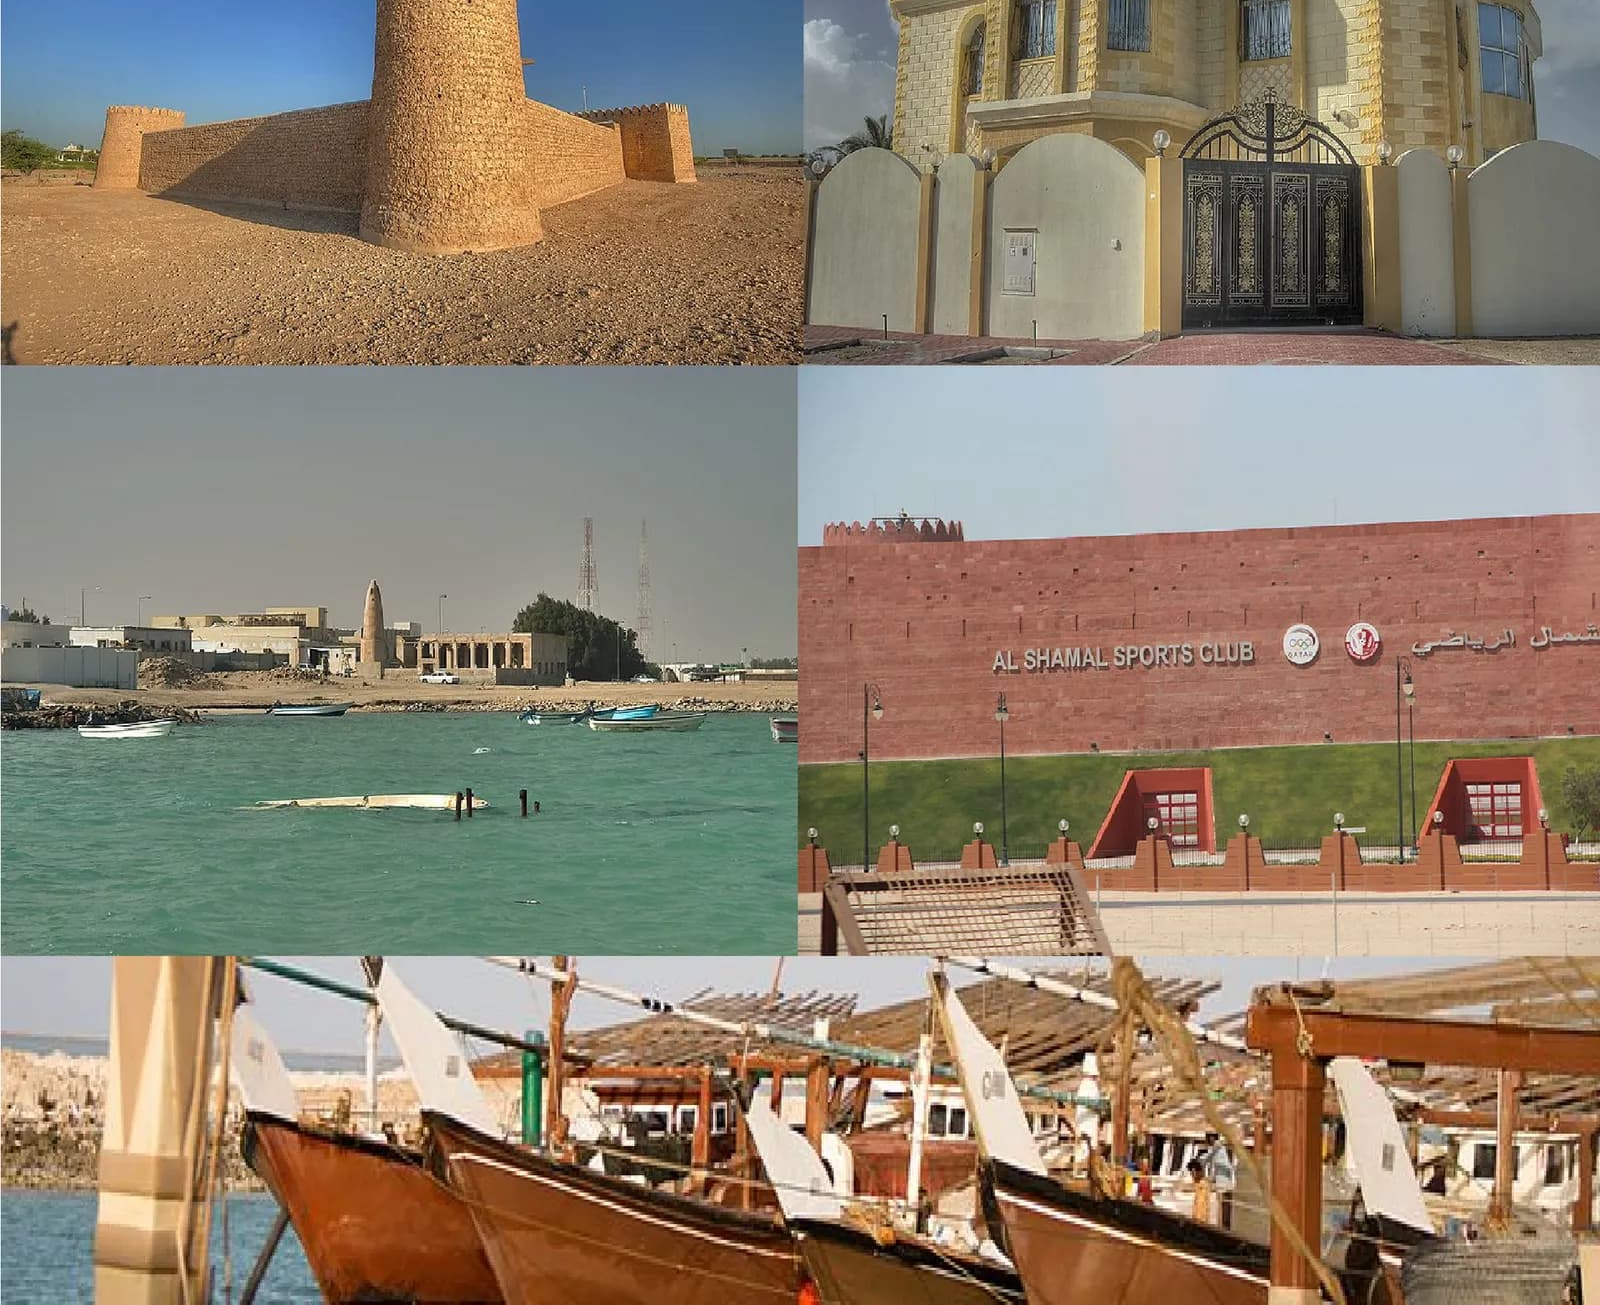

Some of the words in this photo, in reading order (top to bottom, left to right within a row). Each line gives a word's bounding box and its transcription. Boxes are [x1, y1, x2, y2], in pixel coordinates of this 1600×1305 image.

[992, 651, 1019, 671] AL
[1023, 647, 1109, 671] SHAMAL
[1113, 644, 1194, 667] SPORTS
[1199, 641, 1255, 663] CLUB
[1412, 629, 1516, 657] الرياضي
